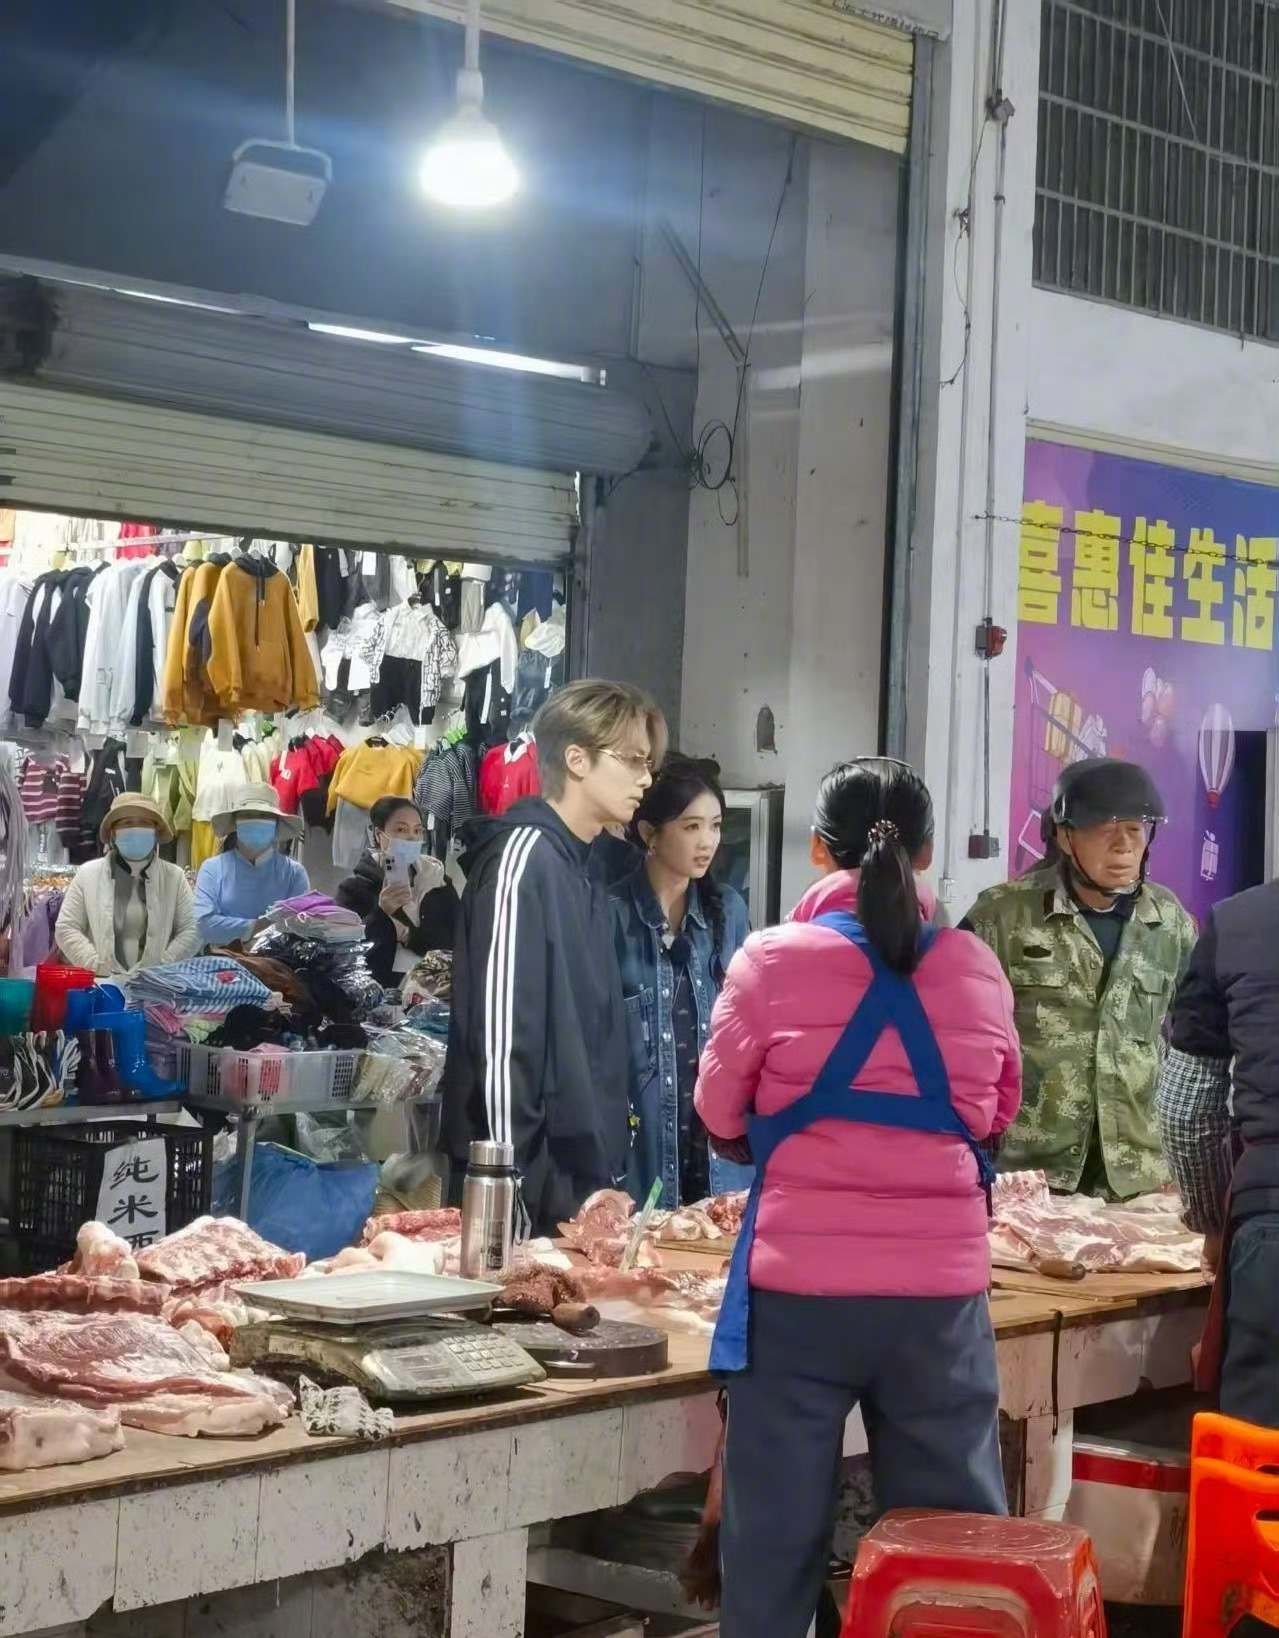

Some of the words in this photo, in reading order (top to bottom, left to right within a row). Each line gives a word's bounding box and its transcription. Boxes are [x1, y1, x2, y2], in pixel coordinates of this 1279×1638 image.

[1018, 500, 1277, 650] 喜惠佳生活
